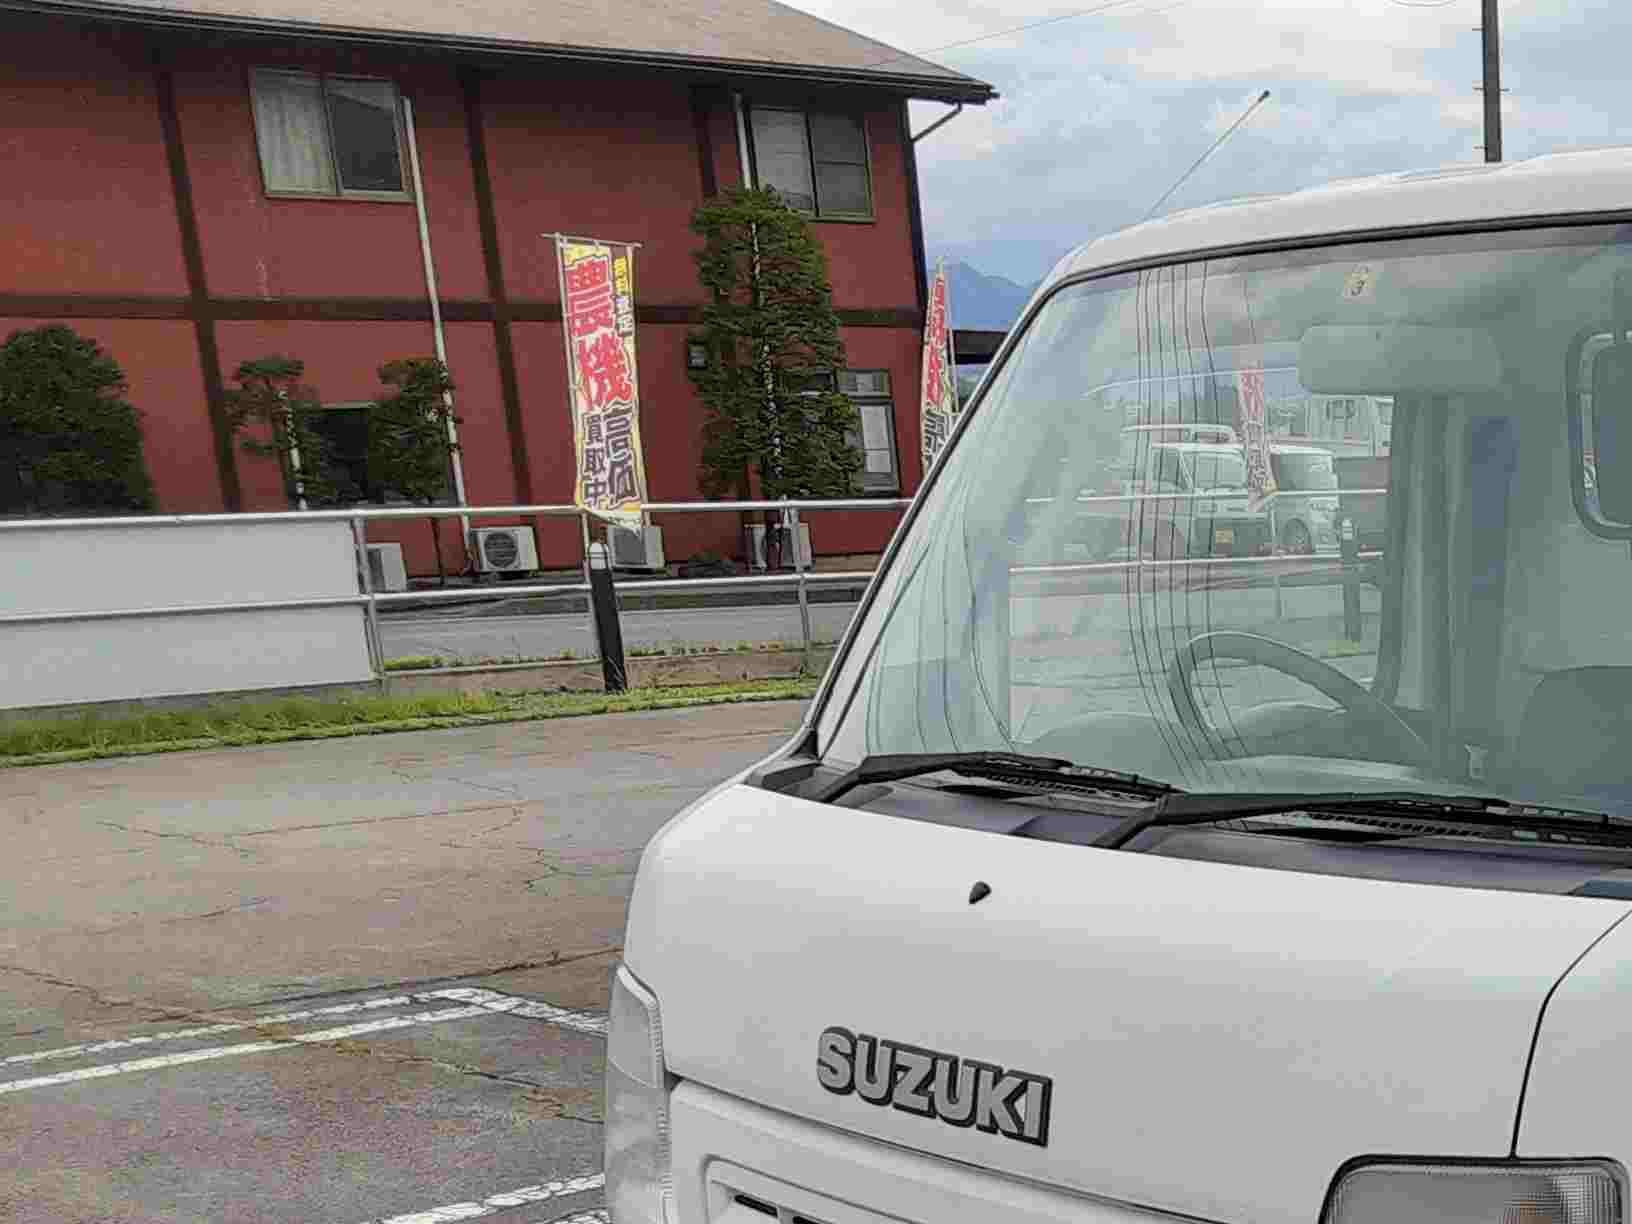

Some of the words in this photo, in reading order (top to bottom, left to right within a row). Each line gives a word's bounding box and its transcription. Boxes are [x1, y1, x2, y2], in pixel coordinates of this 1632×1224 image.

[585, 413, 608, 506] 買取中
[604, 401, 639, 501] 高価
[817, 1026, 1053, 1147] SUZUKI
